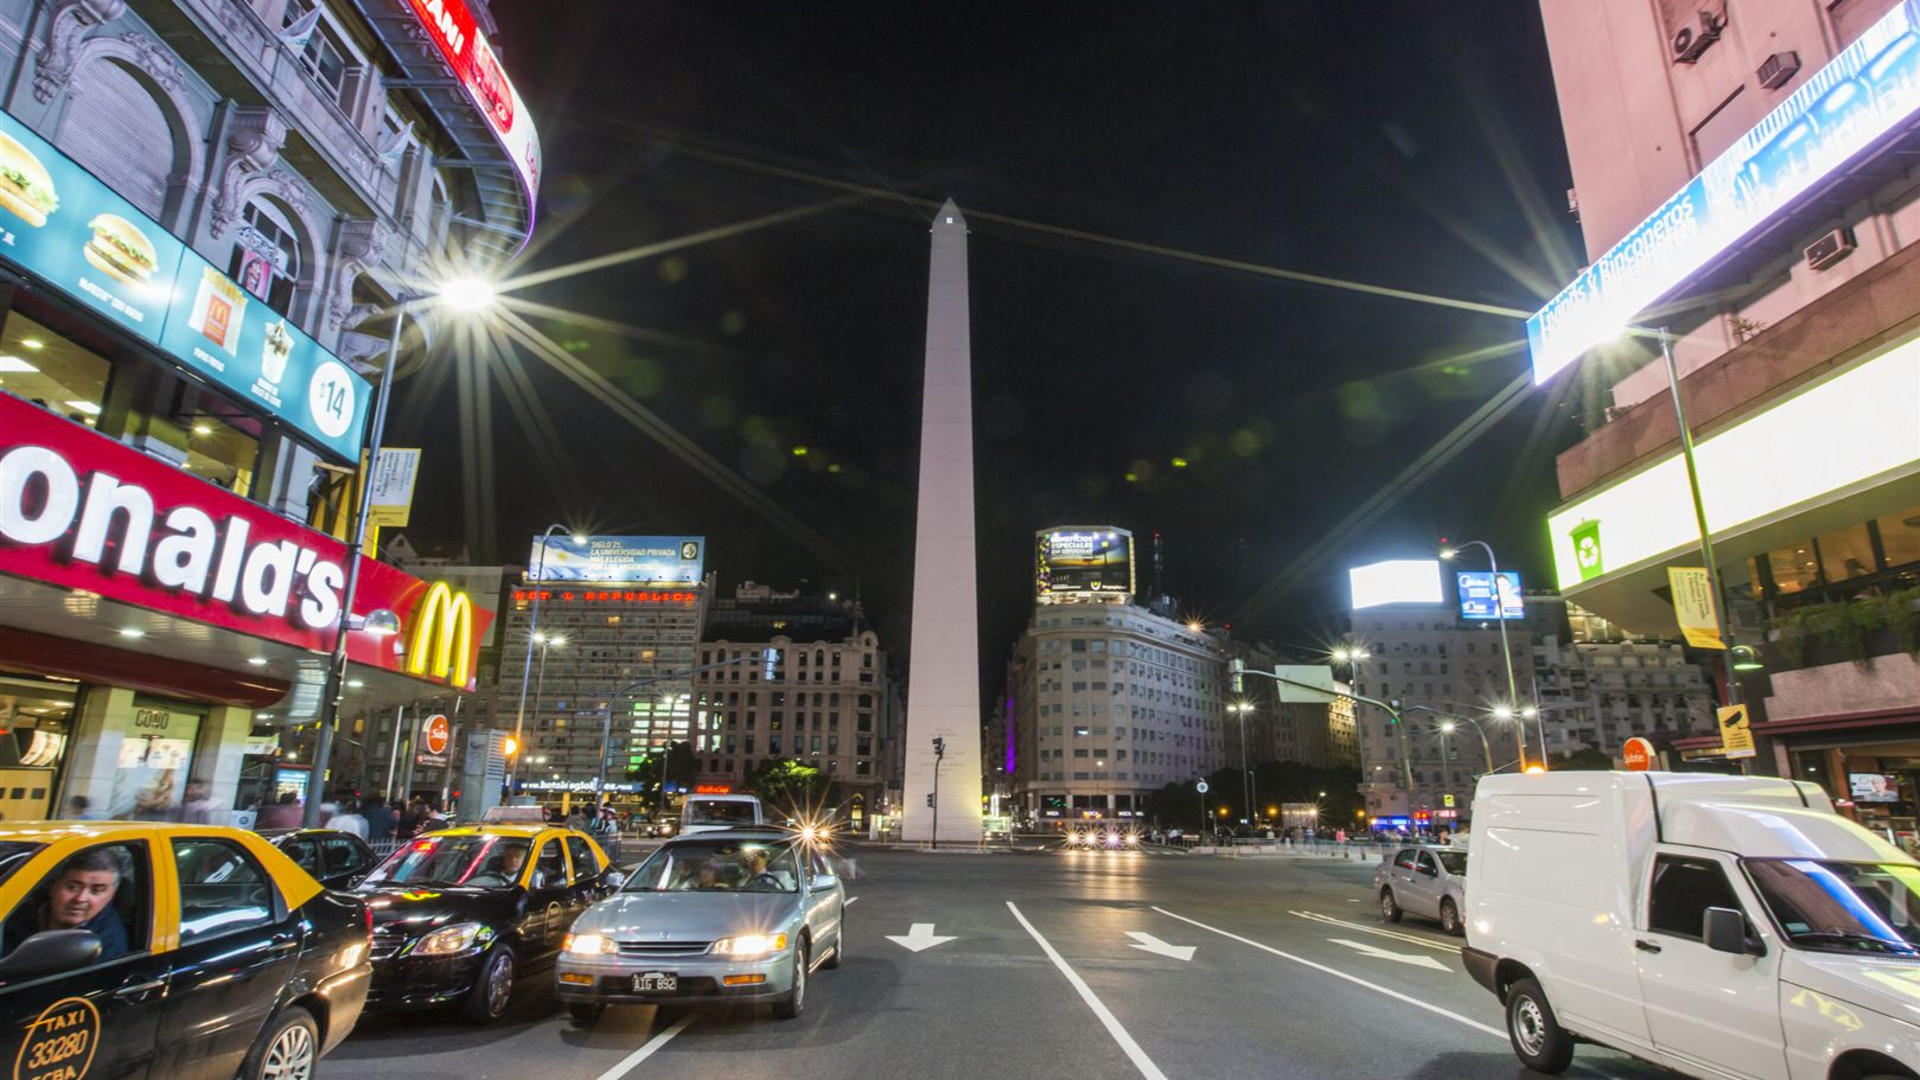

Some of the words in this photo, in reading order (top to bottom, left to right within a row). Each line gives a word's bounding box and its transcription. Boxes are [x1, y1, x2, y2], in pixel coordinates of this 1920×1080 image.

[421, 0, 465, 55] ANI
[634, 978, 652, 990] AIG
[656, 978, 676, 990] 892
[42, 1009, 86, 1033] TAXI
[28, 1029, 89, 1070] 33280
